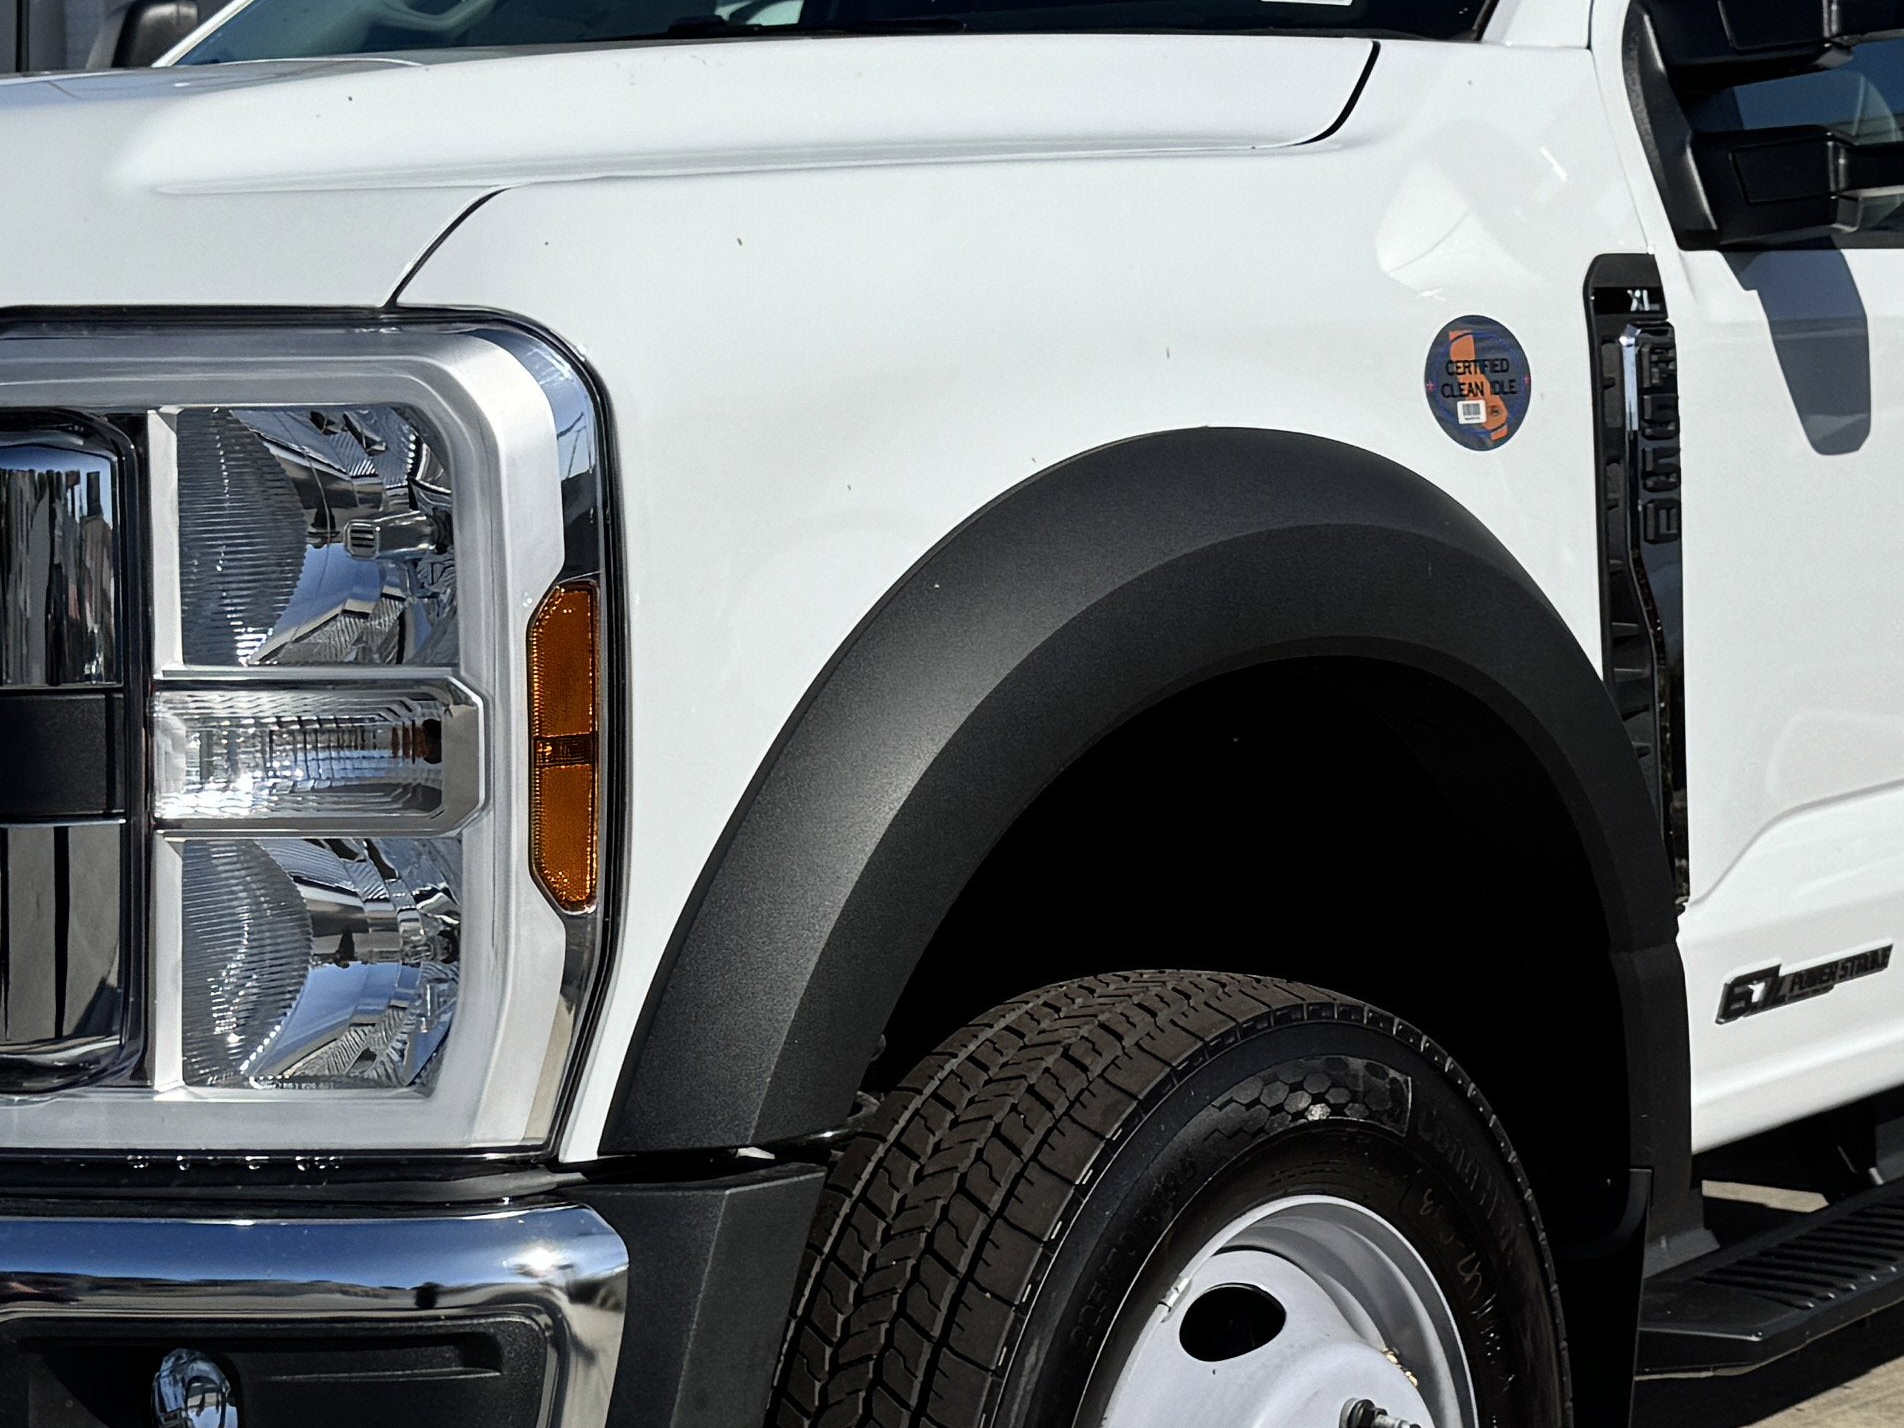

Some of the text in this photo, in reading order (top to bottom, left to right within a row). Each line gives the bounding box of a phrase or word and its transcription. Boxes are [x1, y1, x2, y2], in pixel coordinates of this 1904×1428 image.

[1626, 288, 1661, 312] XL
[1445, 358, 1510, 376] CERTIFIED
[1440, 381, 1484, 399] CLEAN
